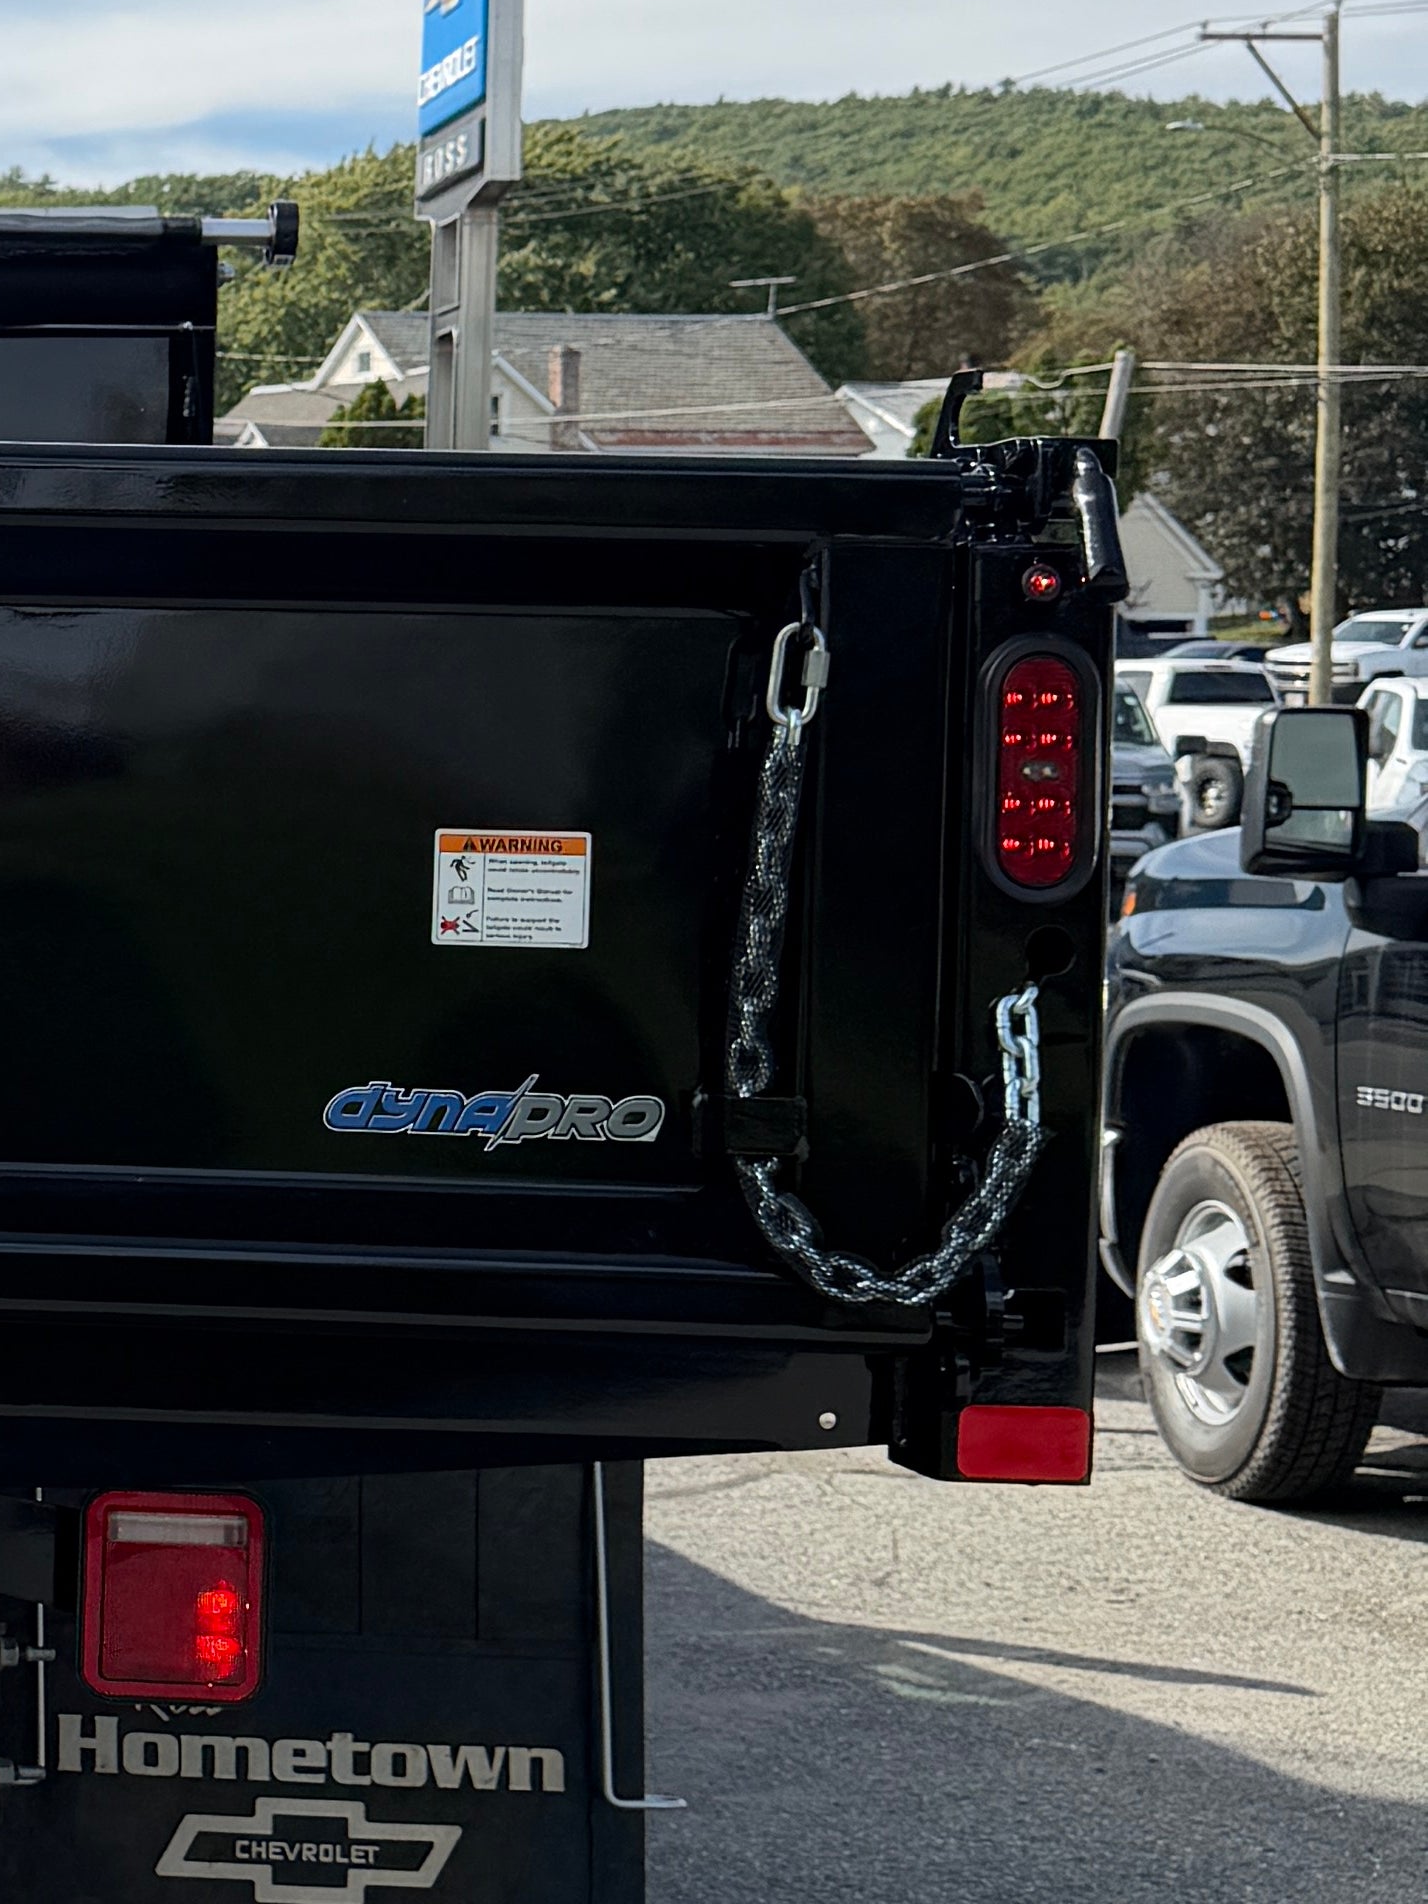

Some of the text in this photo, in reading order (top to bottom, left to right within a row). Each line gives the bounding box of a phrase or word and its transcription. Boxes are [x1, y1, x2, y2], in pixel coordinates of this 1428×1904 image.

[422, 133, 468, 185] ROSS
[479, 838, 563, 852] WARNING
[1356, 1086, 1424, 1113] 3500
[57, 1713, 566, 1792] Hometown
[235, 1839, 380, 1864] CHEVROLET
